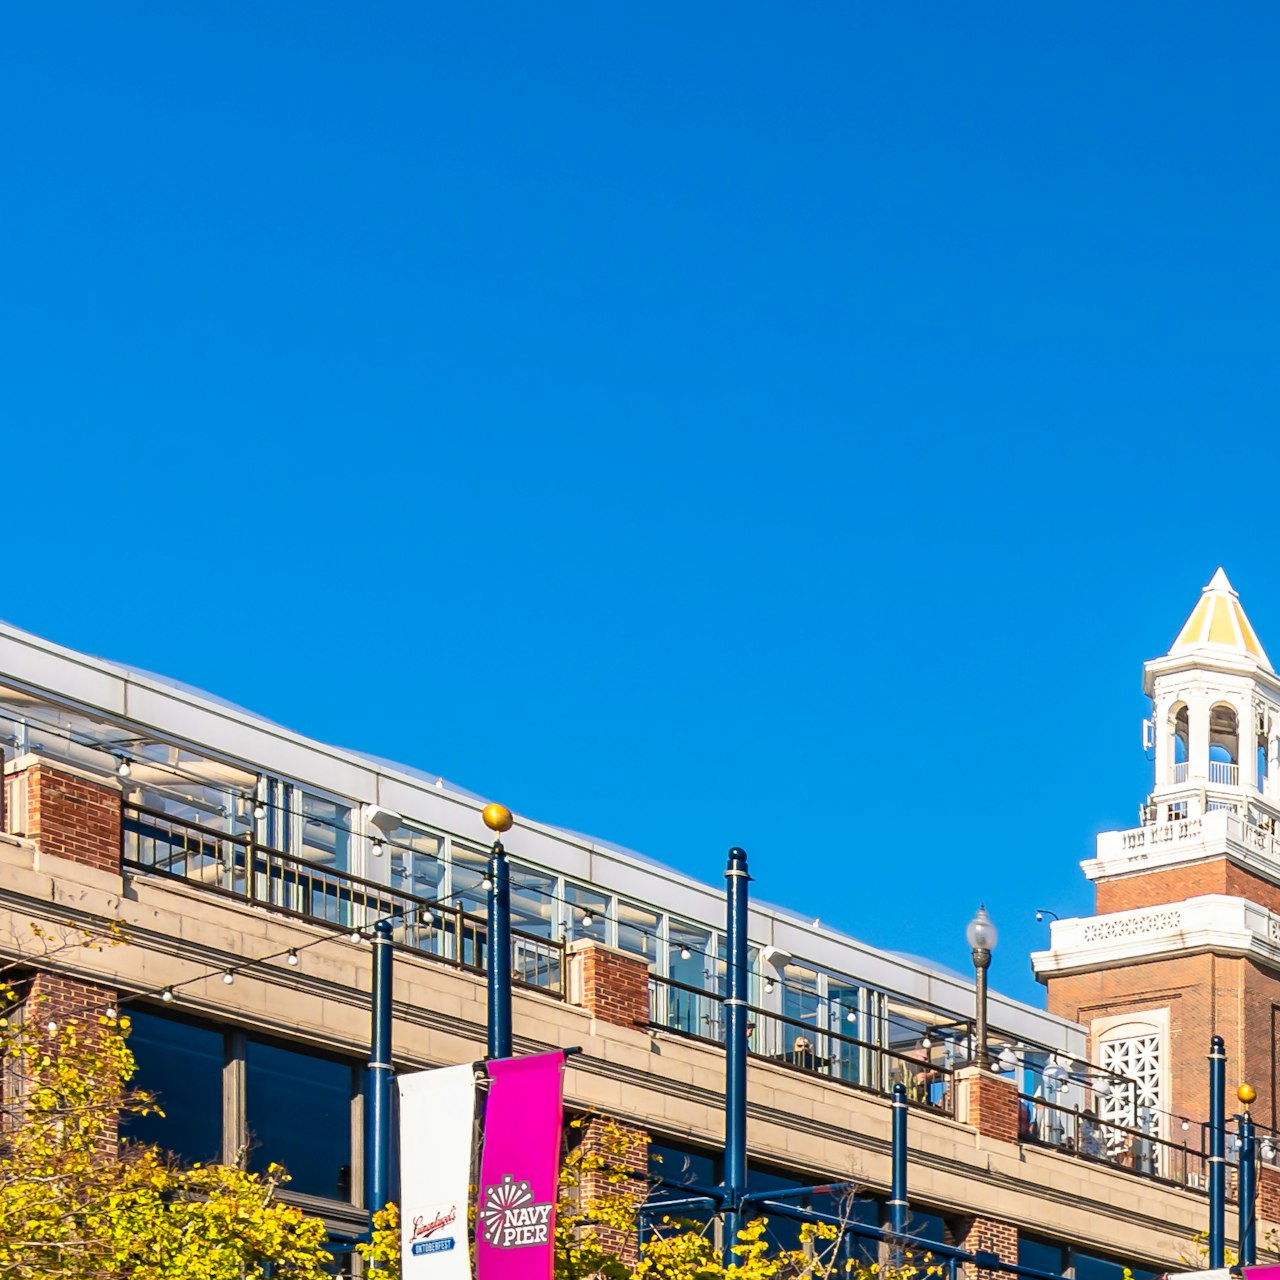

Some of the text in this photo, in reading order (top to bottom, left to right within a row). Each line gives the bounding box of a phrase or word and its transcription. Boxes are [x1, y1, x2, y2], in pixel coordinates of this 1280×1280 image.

[503, 1204, 553, 1228] NAVY
[415, 1239, 452, 1254] OKTOBERFEST
[503, 1224, 548, 1247] PIER
